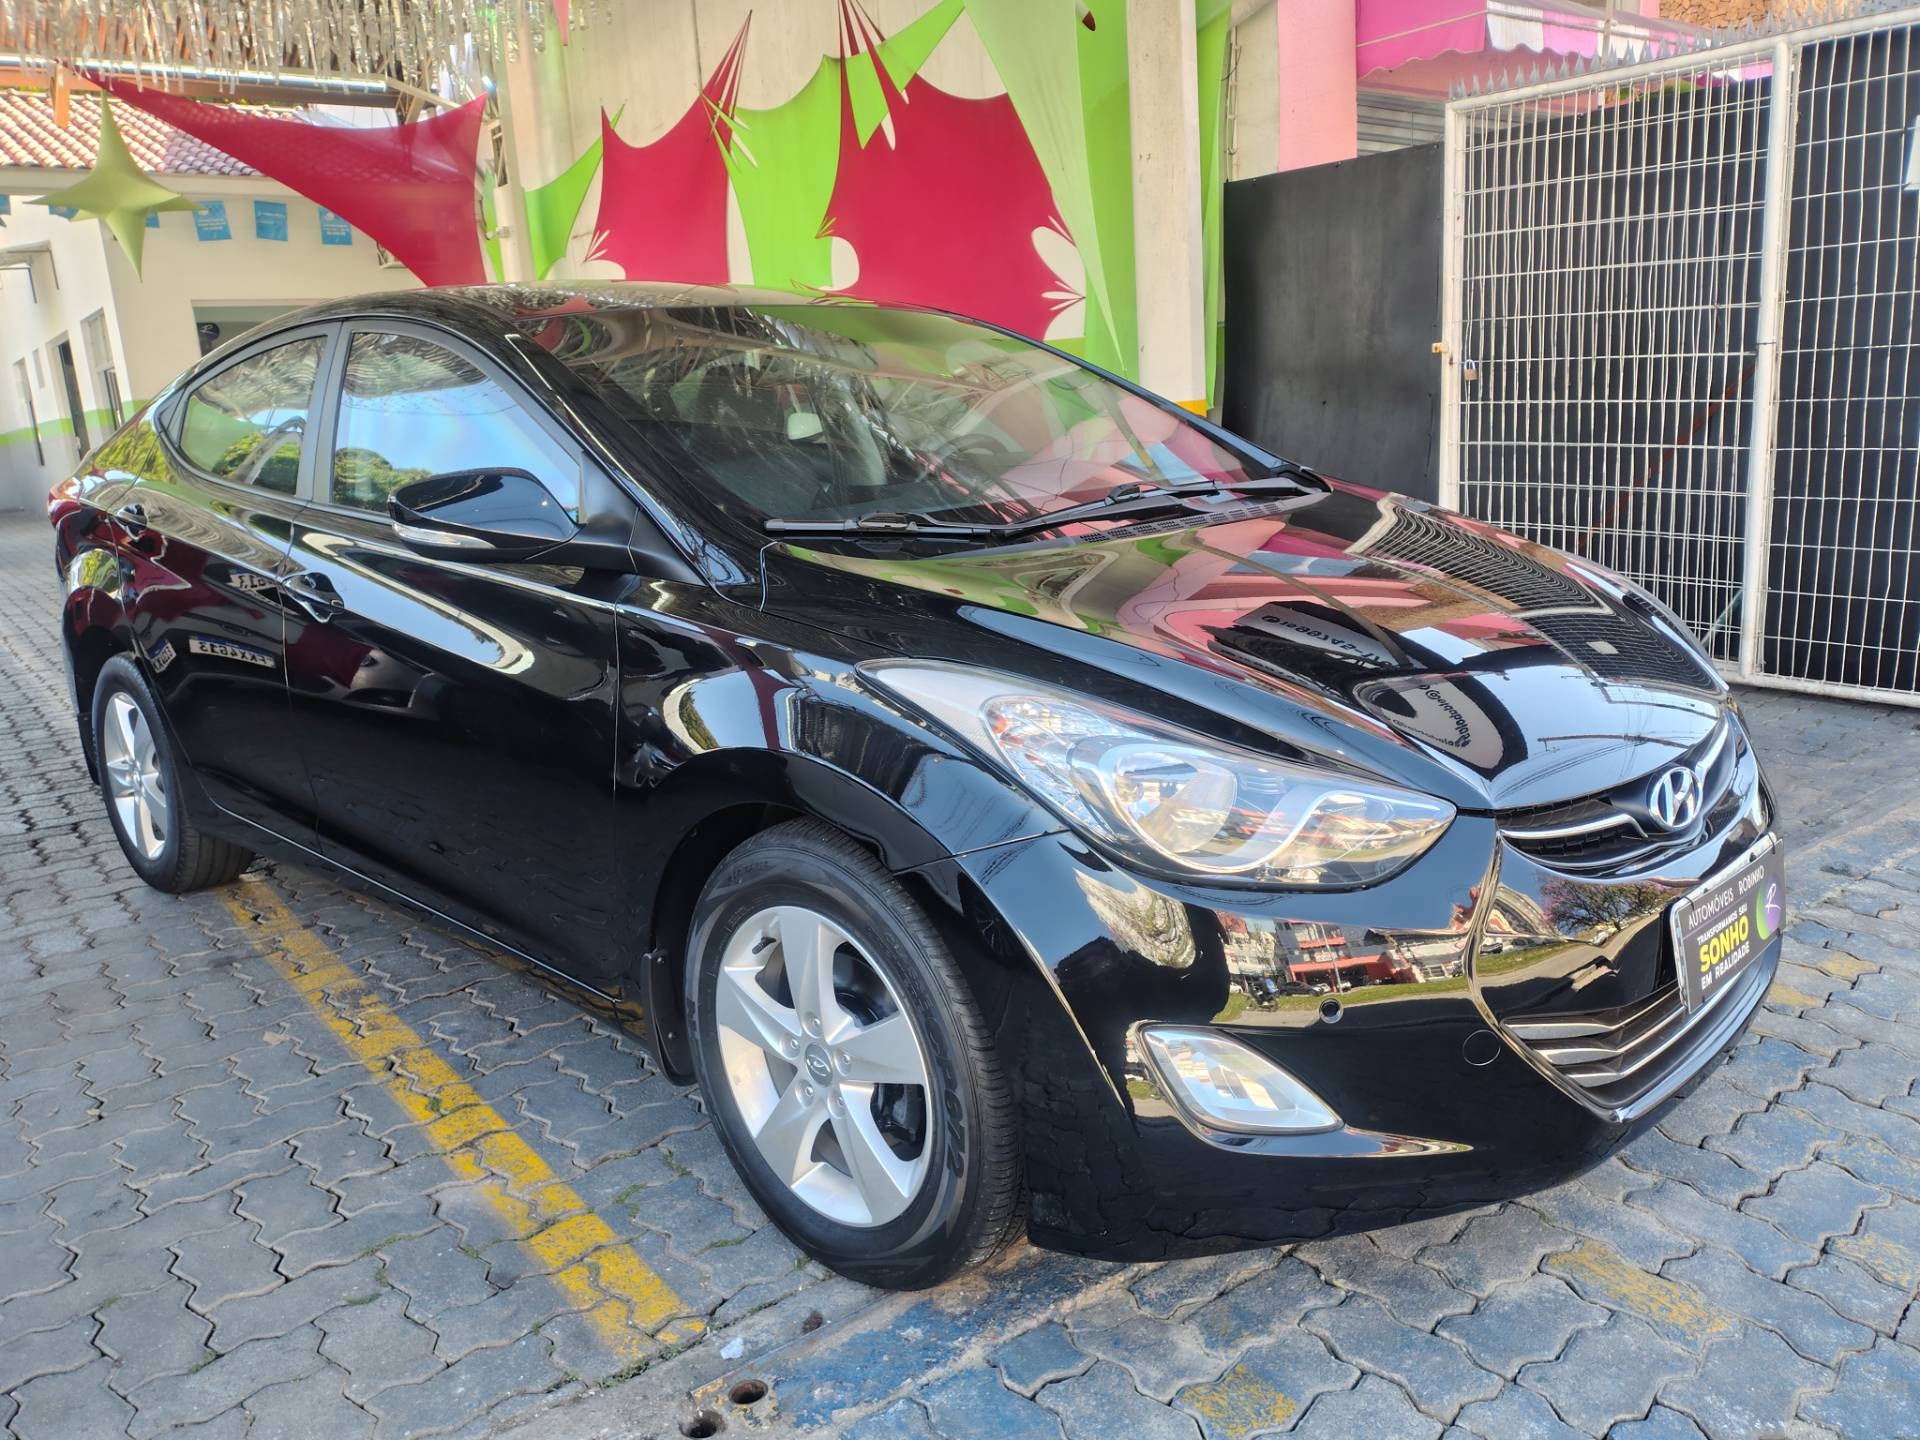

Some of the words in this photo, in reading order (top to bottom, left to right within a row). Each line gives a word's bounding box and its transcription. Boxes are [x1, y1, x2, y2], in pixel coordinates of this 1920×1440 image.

[1688, 887, 1734, 930] AUTOMÓVEIS
[1700, 915, 1749, 972] SONHO
[1701, 971, 1713, 990] EM
[1715, 941, 1750, 979] REALIDADE
